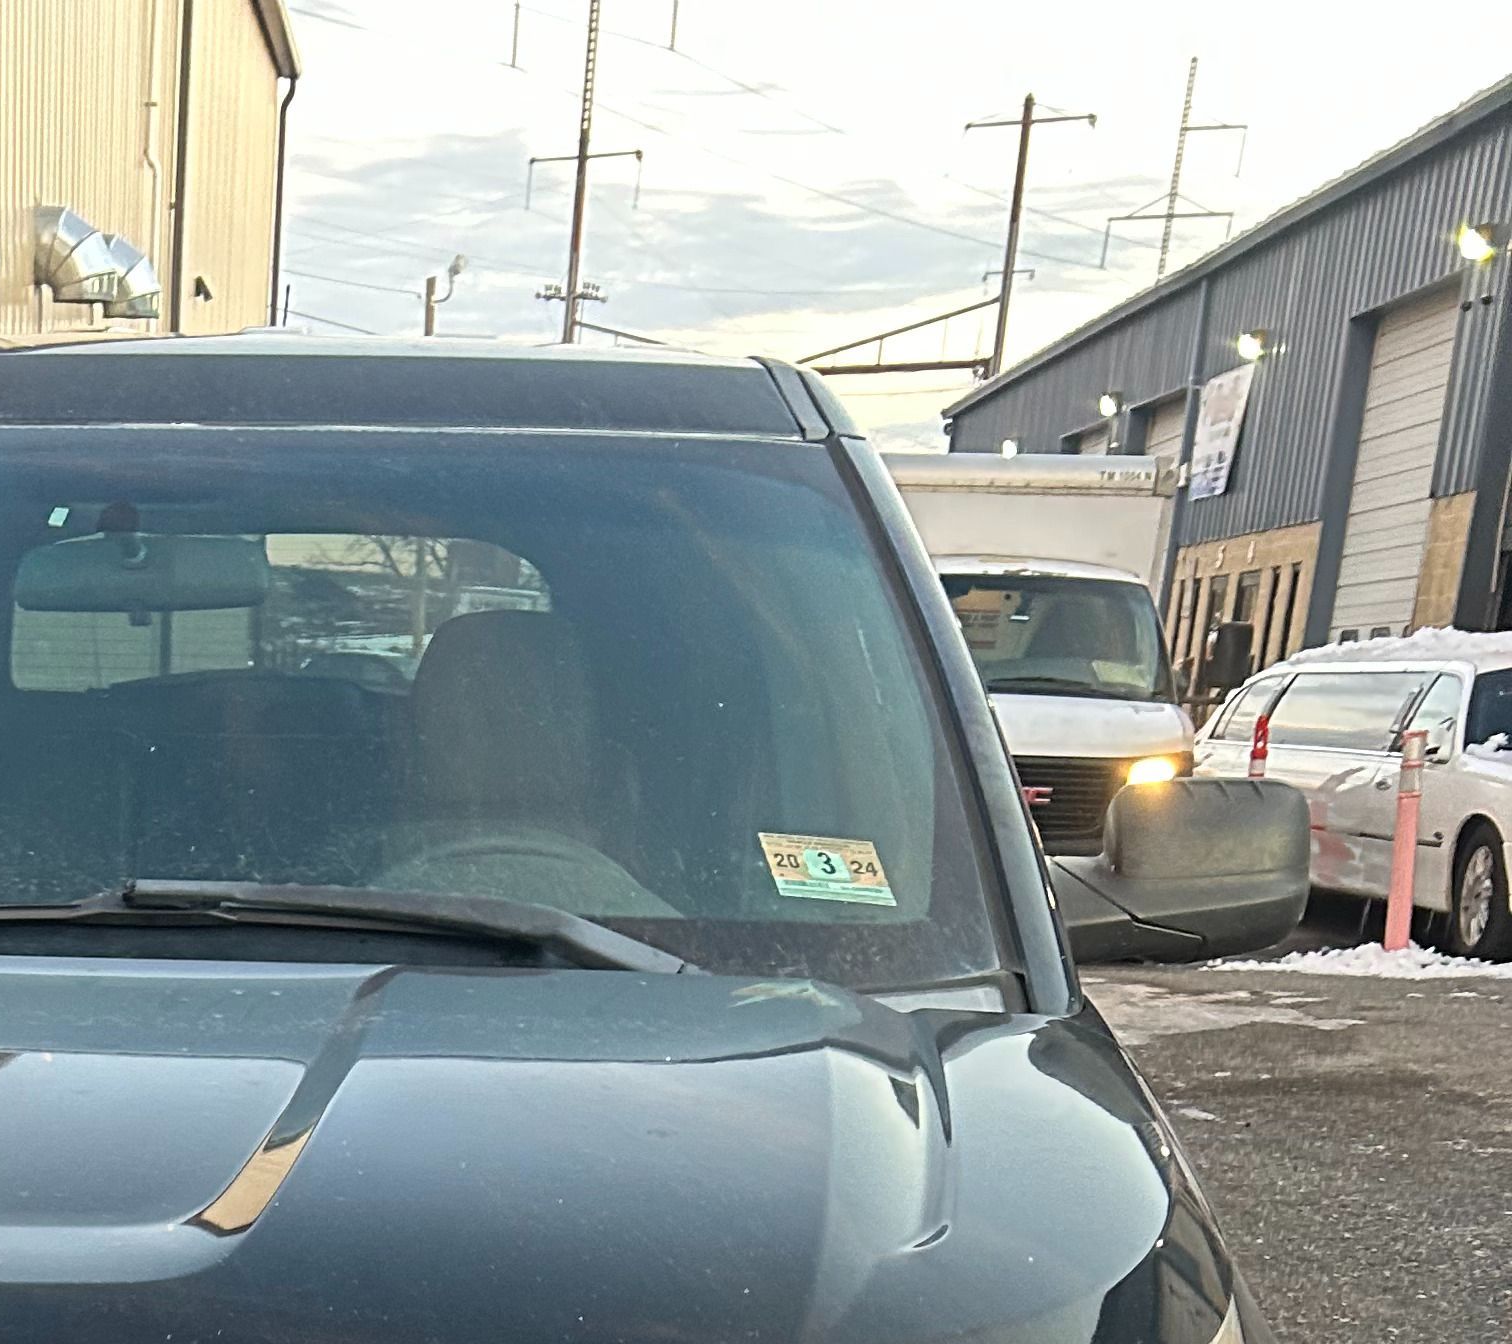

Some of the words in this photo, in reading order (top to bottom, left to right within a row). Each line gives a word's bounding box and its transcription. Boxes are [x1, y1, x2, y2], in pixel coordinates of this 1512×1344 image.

[774, 853, 800, 869] 20
[817, 852, 837, 875] 3
[850, 860, 878, 877] 24
